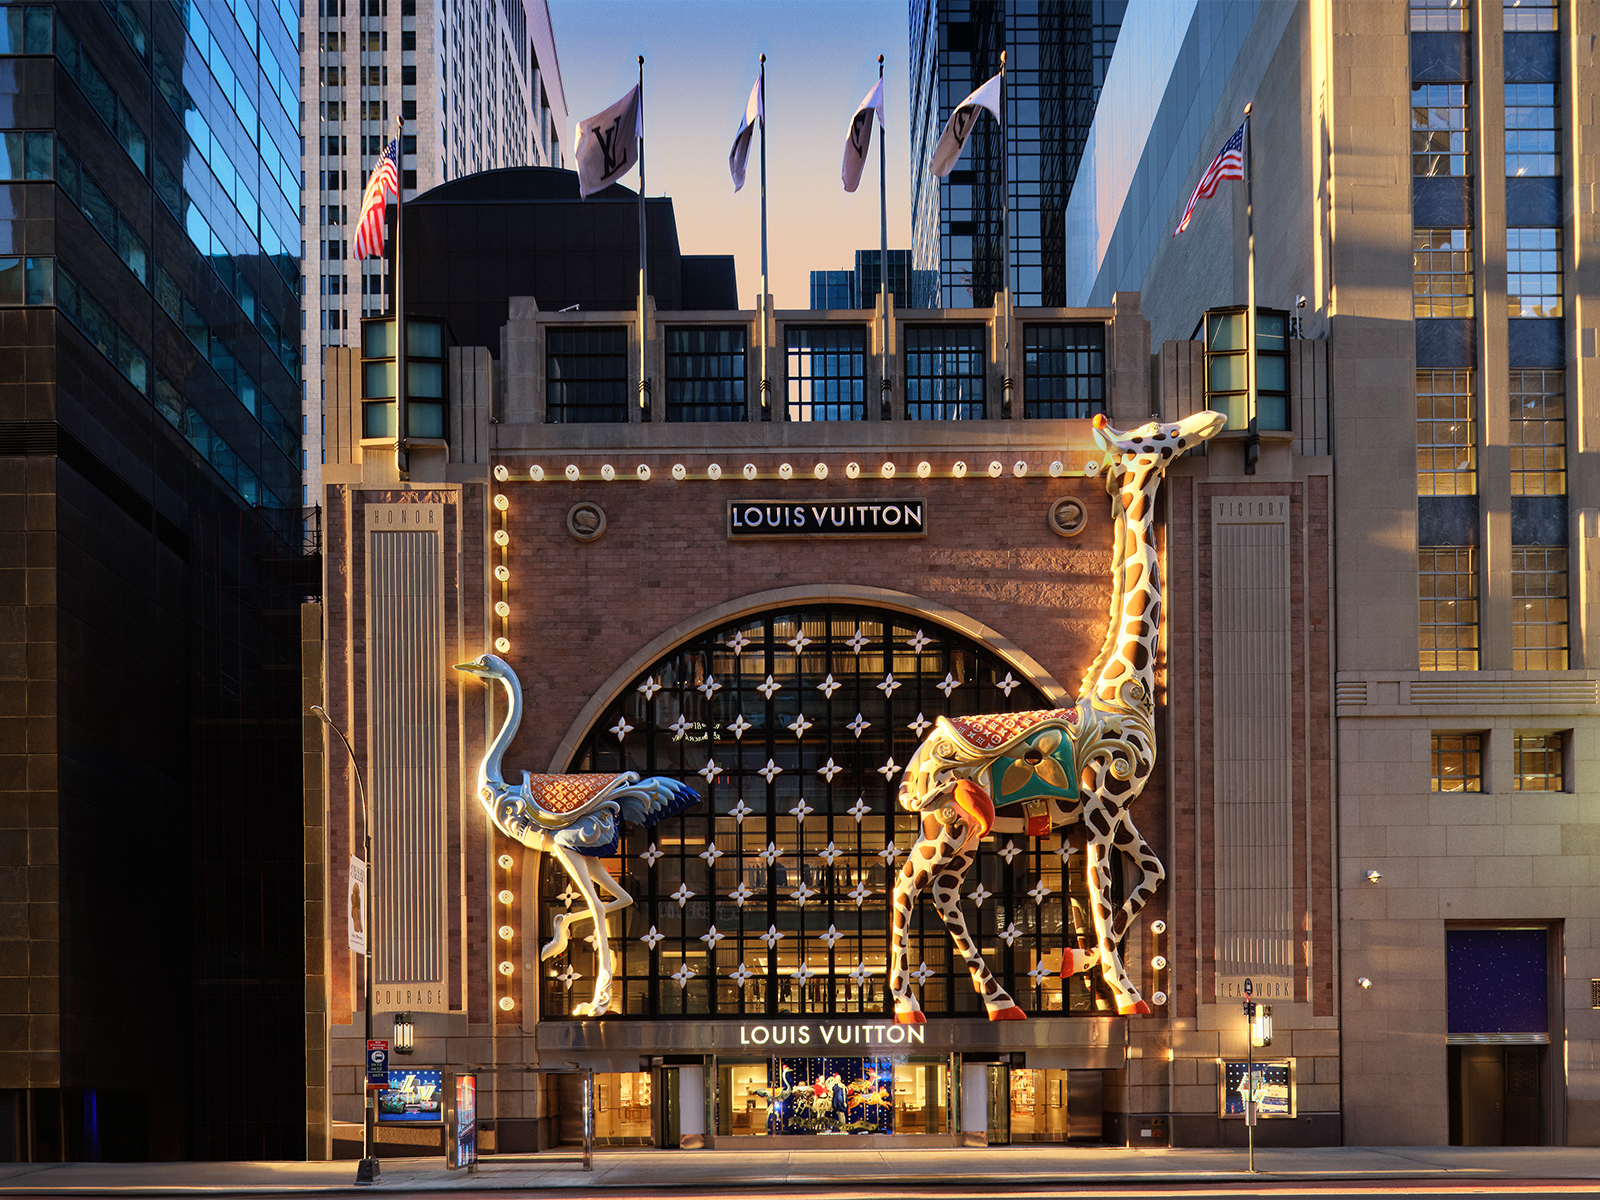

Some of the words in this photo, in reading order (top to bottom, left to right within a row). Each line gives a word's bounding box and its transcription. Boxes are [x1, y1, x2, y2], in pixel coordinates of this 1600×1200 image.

[374, 509, 434, 524] HONOR
[733, 506, 805, 527] LOUIS
[812, 504, 922, 527] VUITTON
[1219, 502, 1284, 516] VICTORY
[375, 989, 442, 1005] COURAGE
[1220, 982, 1290, 997] TEAWORK
[740, 1025, 810, 1045] LOUIS
[819, 1025, 925, 1044] VUITTON
